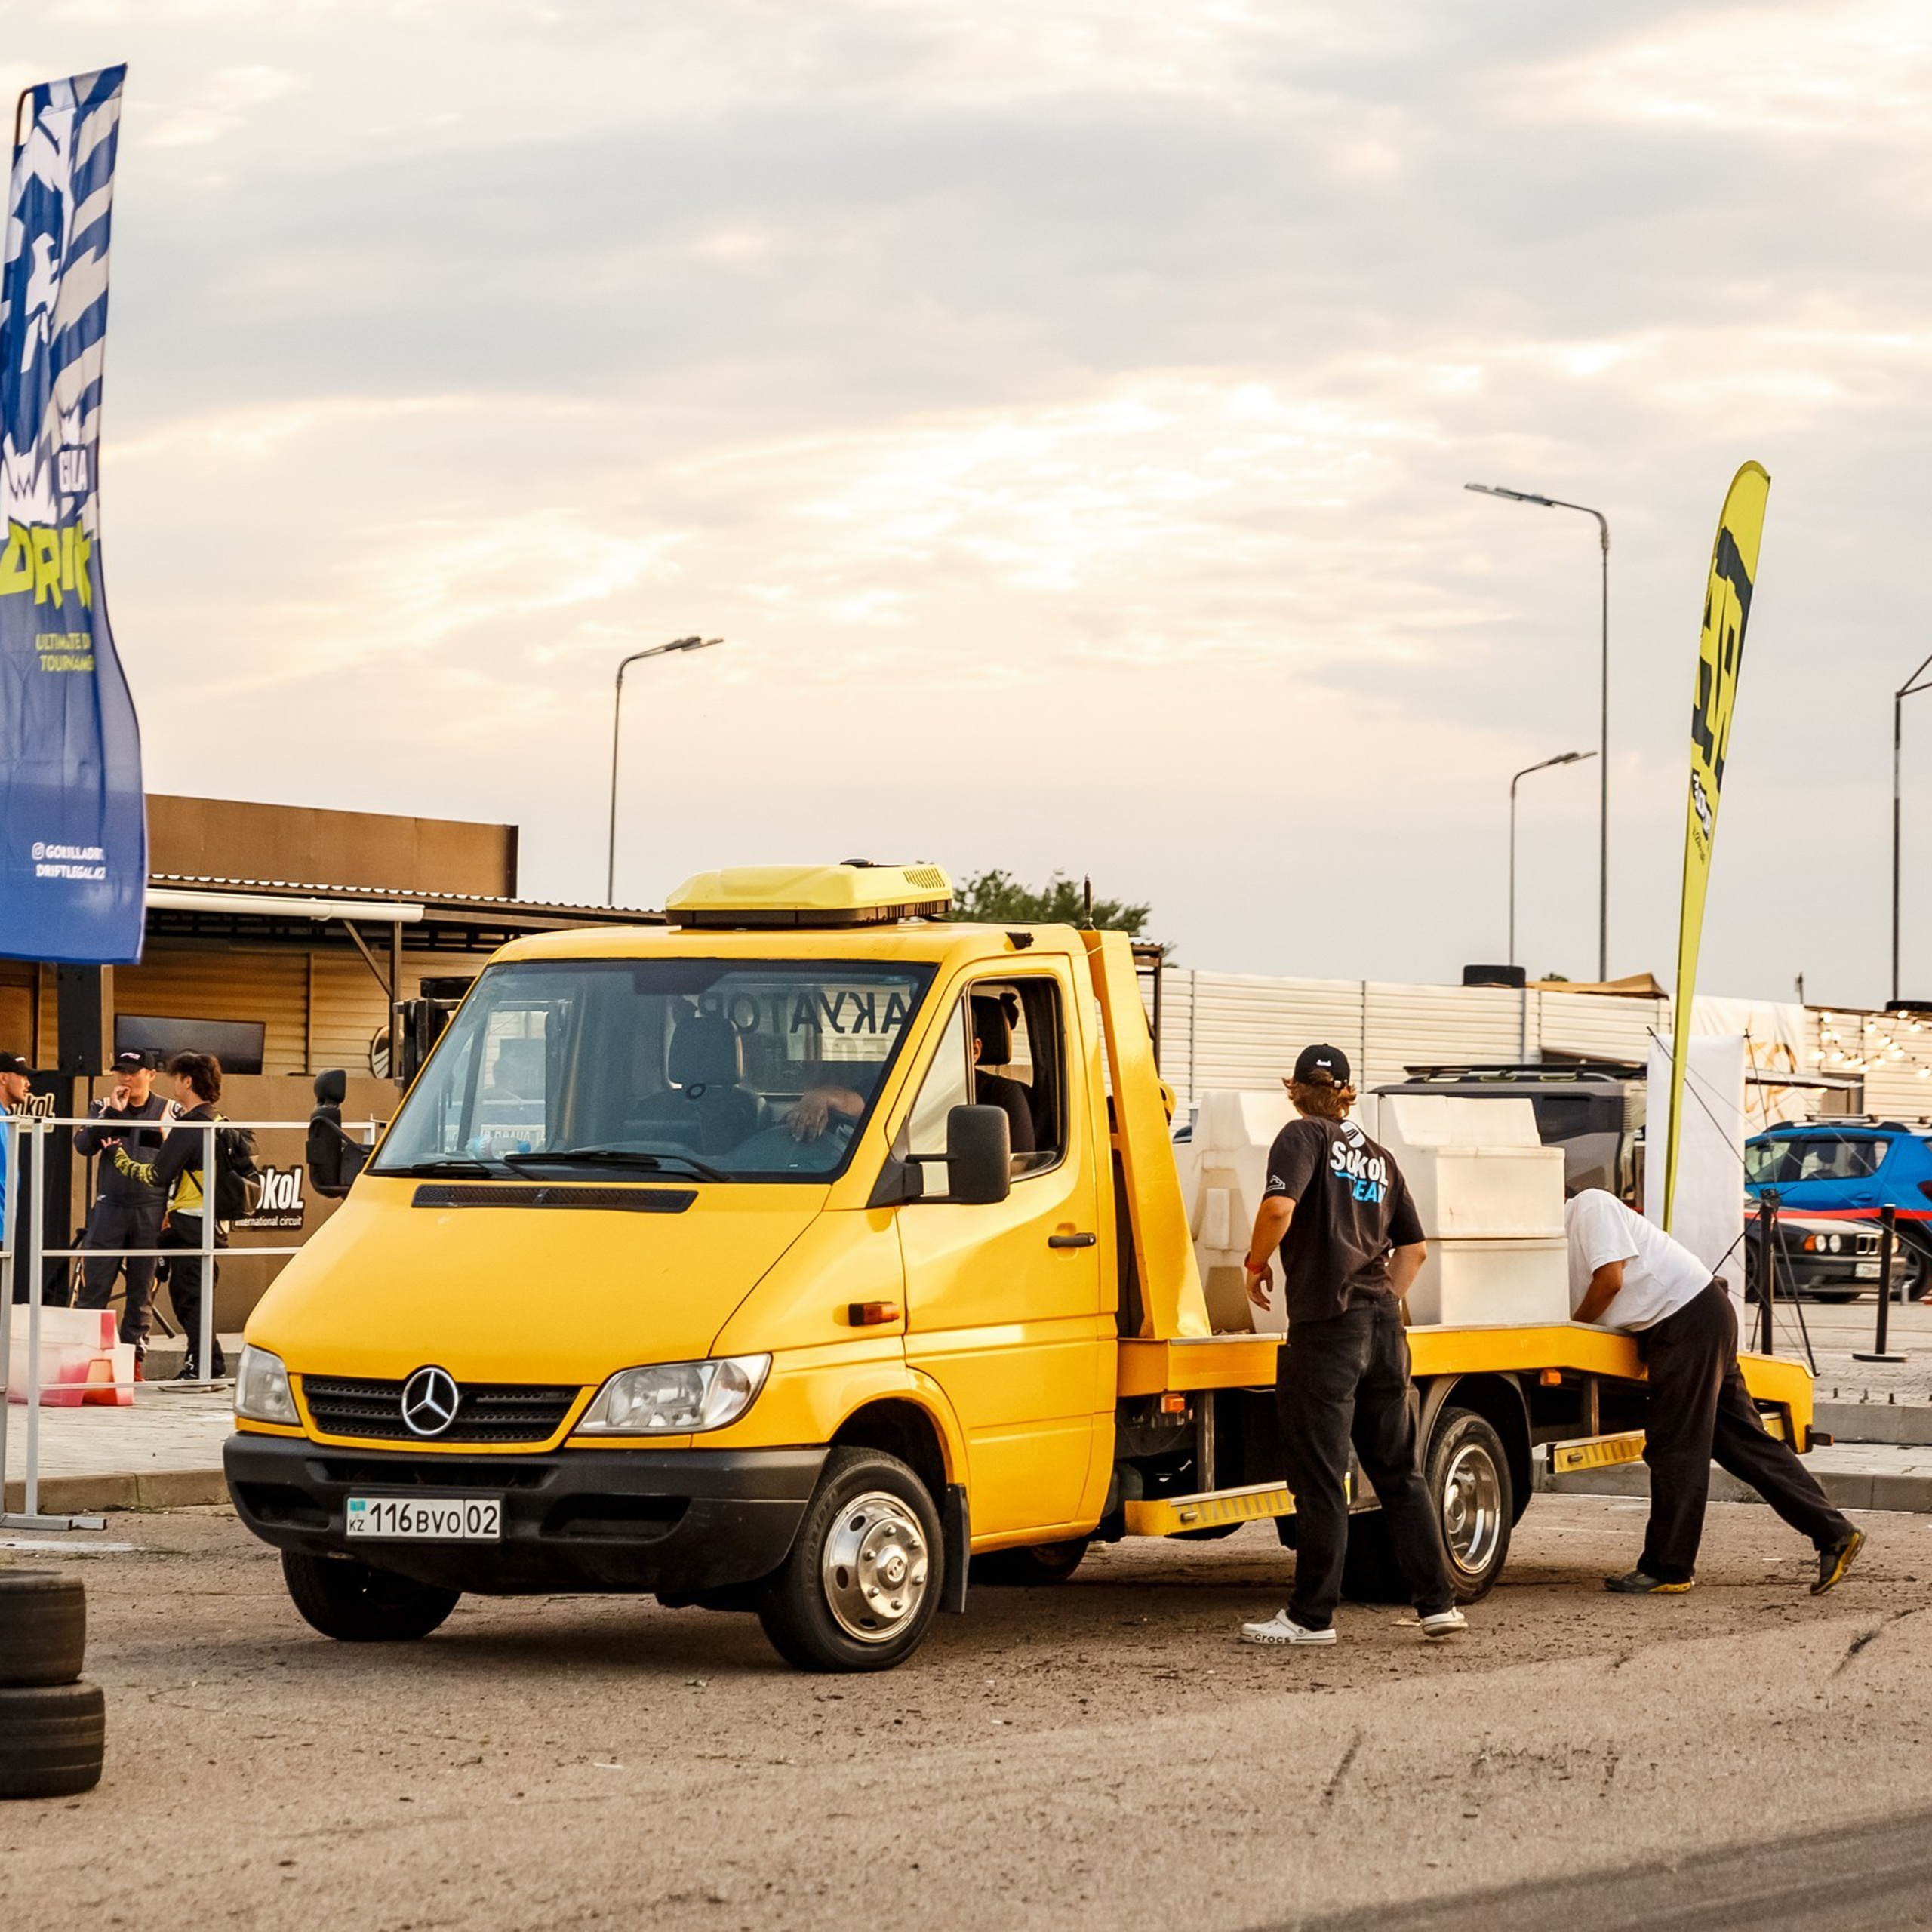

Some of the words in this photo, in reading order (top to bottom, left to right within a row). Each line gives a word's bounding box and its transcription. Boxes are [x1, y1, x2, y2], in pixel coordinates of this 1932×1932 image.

[349, 1518, 365, 1531] KZ
[466, 1505, 498, 1534] 02
[1255, 1634, 1291, 1644] crocs
